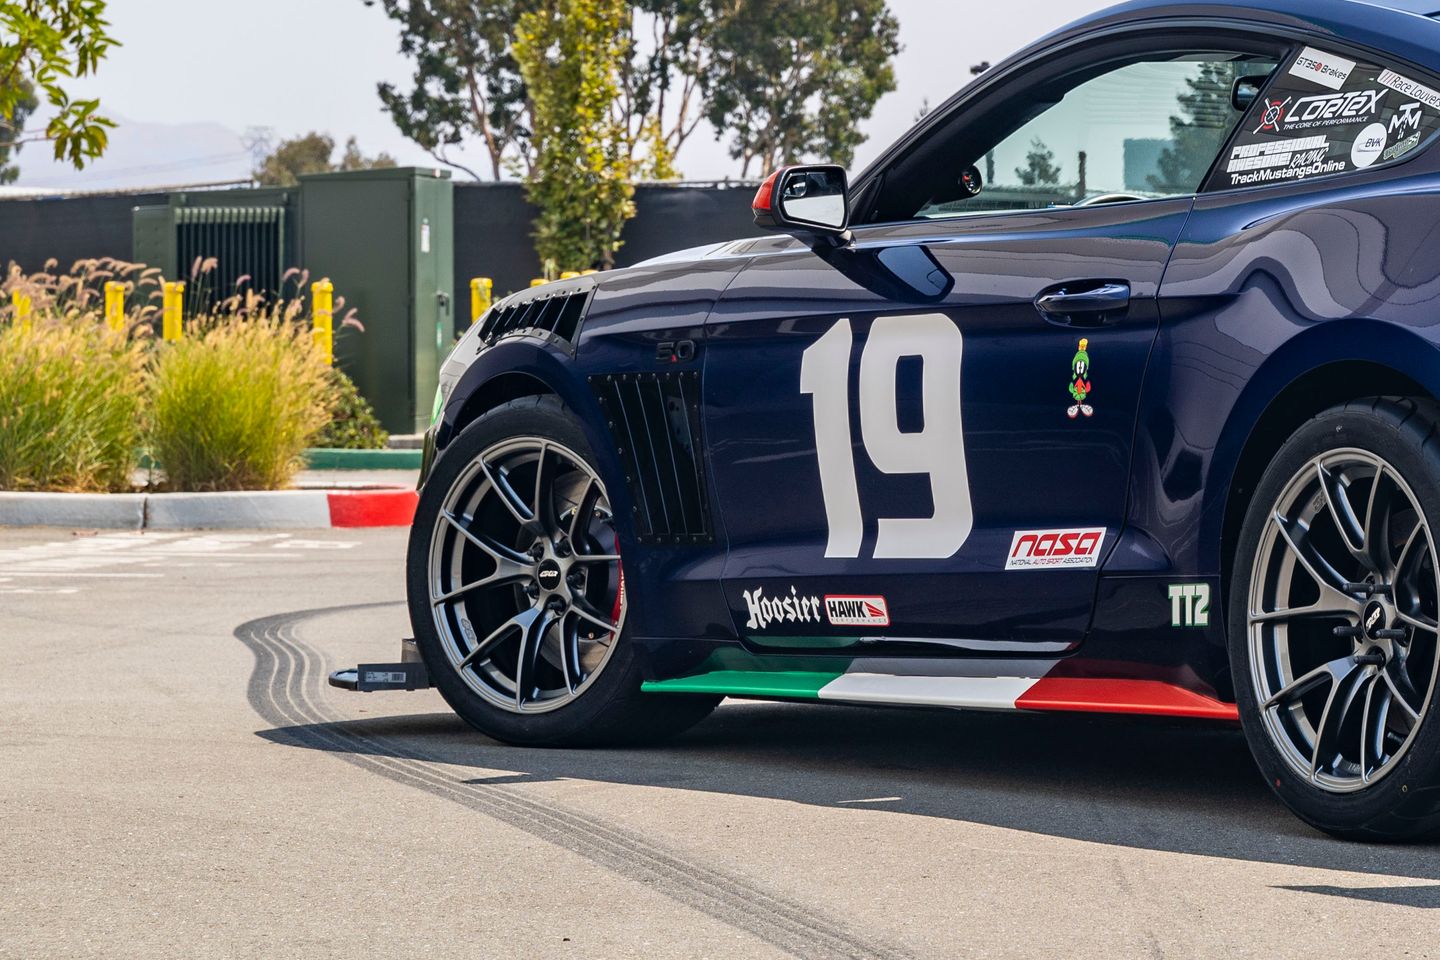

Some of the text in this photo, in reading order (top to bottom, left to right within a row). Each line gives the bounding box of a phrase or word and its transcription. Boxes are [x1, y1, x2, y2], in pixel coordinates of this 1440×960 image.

[1321, 64, 1347, 80] Brakes
[1392, 76, 1412, 93] Race
[1322, 116, 1369, 126] PERFORMANCE
[1230, 135, 1330, 159] PROFESSIONAL
[1289, 147, 1329, 168] RACING
[1230, 161, 1346, 185] TrackMustangsOnline
[800, 312, 973, 559] 19
[742, 585, 820, 629] Hoosier
[827, 601, 867, 617] HAWK
[1168, 583, 1211, 627] TT2
